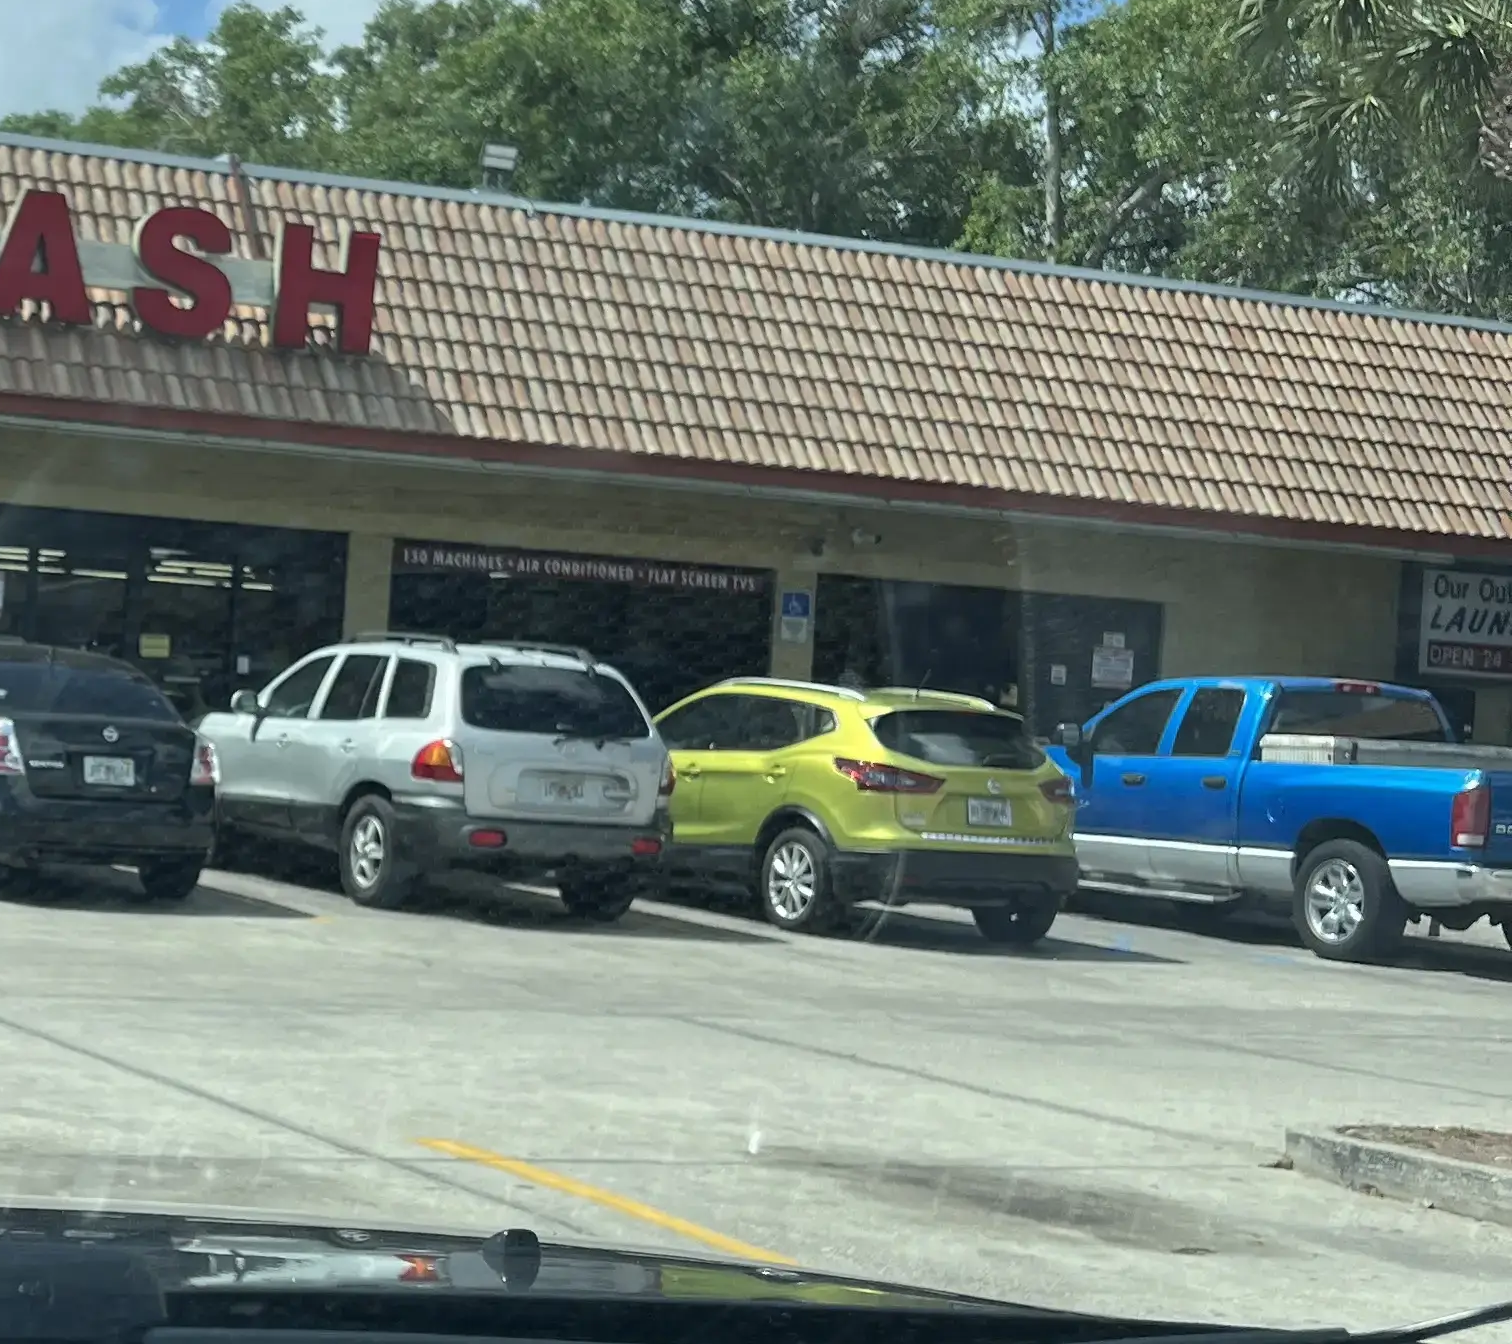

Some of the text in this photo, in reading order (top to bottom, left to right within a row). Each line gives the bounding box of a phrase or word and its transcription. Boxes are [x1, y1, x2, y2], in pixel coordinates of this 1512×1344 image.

[433, 549, 503, 571] MACHINES
[517, 557, 541, 573] AIR
[544, 558, 634, 582] CONDITIONED
[648, 568, 677, 585] FLAT
[681, 570, 728, 590] SCREEN
[733, 574, 756, 592] TVS
[1434, 573, 1470, 599] Our
[1430, 603, 1512, 636] LAUN
[1430, 643, 1475, 668] OPEN
